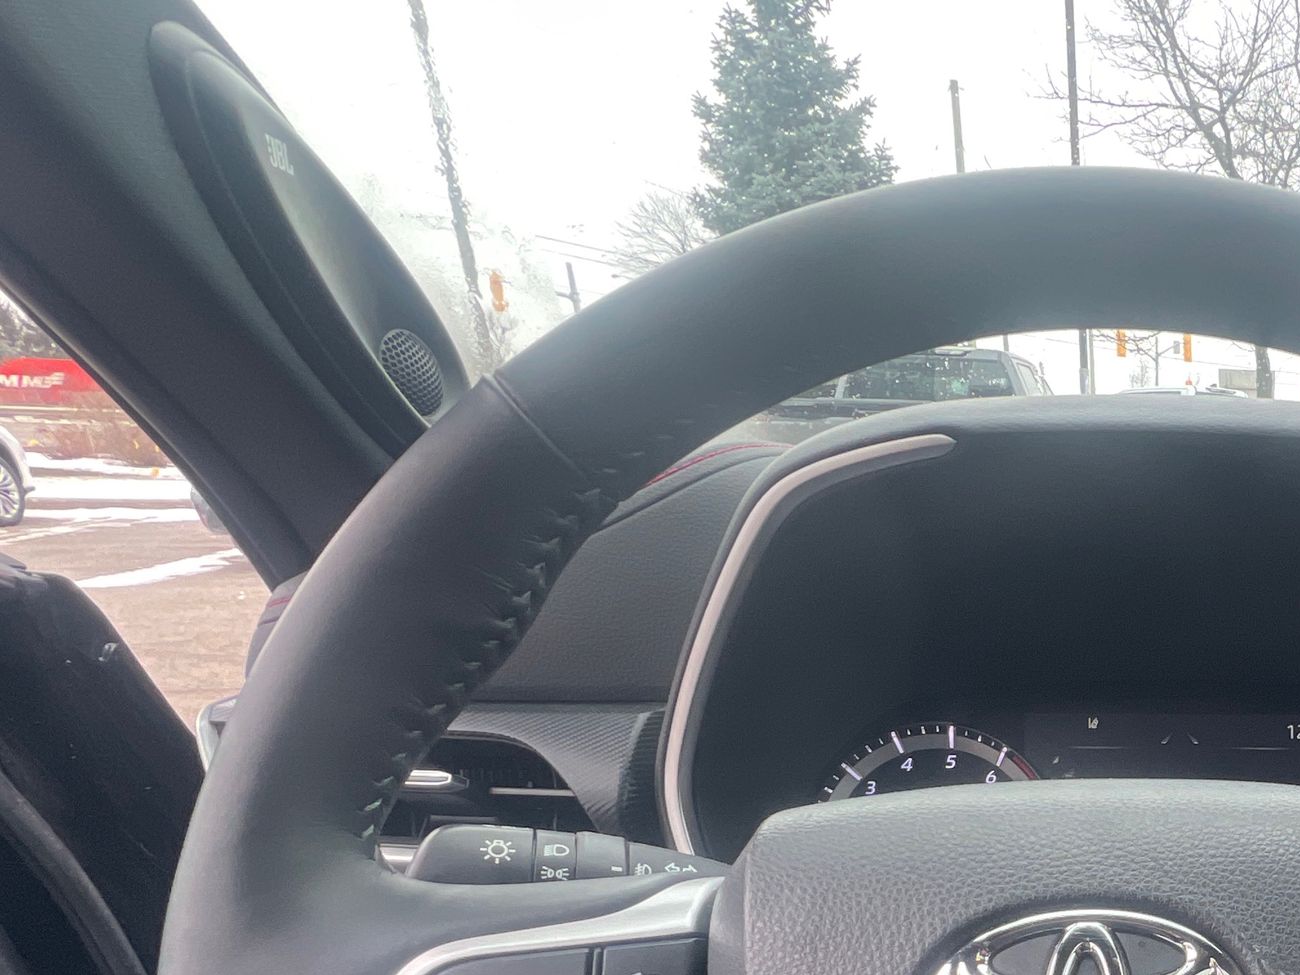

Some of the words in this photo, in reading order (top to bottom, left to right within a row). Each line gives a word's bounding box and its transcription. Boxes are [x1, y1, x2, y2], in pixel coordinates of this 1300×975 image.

[264, 132, 294, 176] JBL
[901, 757, 913, 772] 4
[945, 754, 956, 769] 5
[985, 770, 997, 784] 6
[865, 780, 877, 795] 3
